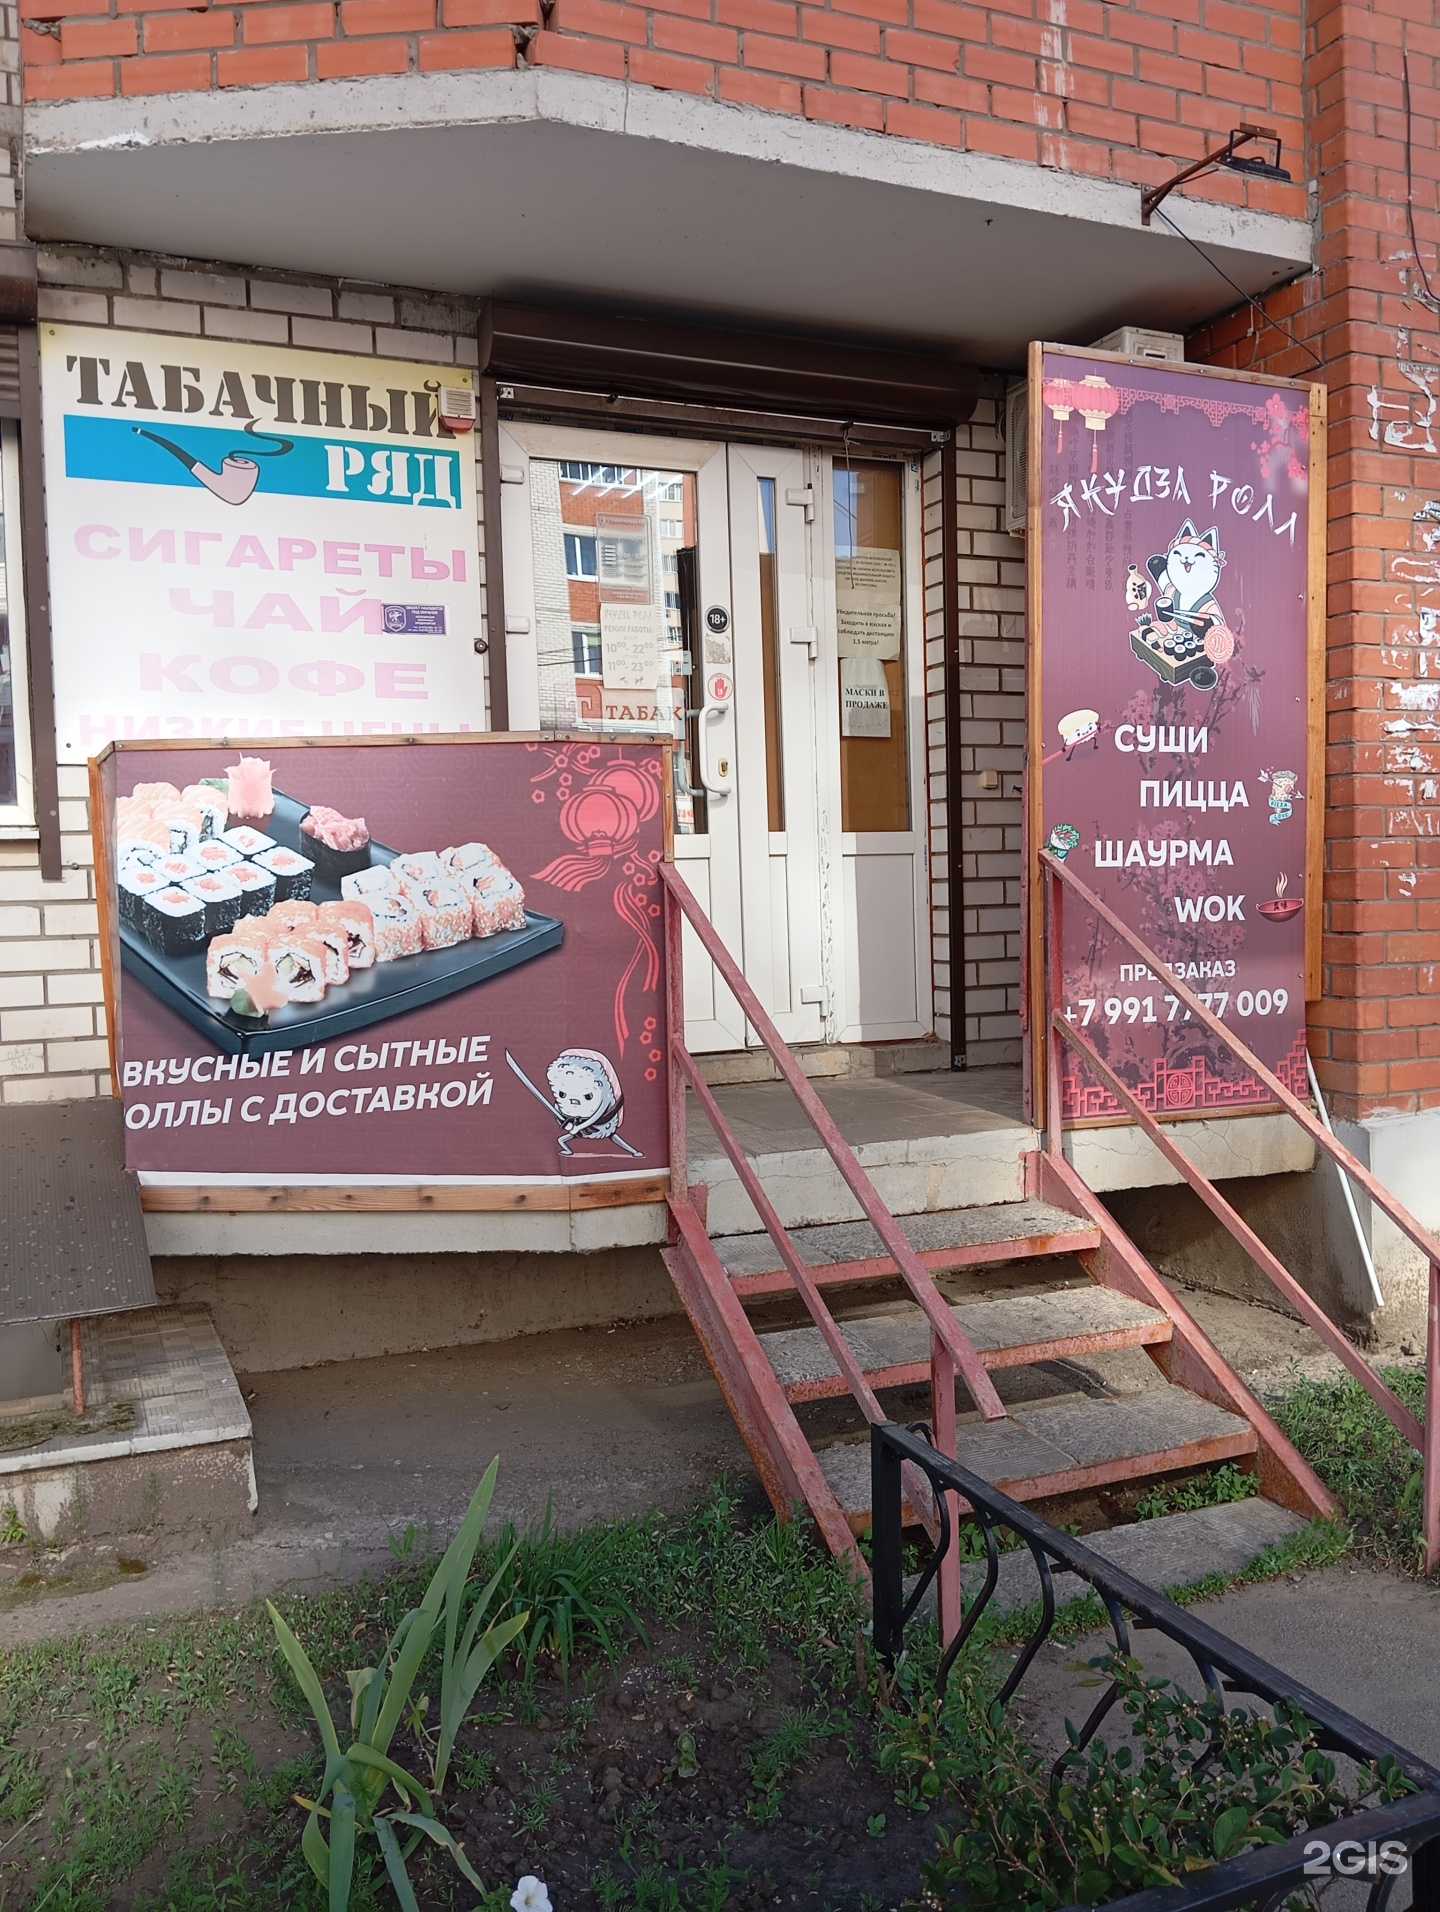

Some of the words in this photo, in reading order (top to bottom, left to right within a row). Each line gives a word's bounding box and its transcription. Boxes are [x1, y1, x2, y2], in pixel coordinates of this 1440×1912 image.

[66, 354, 457, 440] ТАБАЧНЫЙ
[324, 445, 456, 508] РЯД
[1209, 470, 1298, 547] РОЛЛ
[73, 523, 467, 582] СИГАРЕТЫ
[168, 587, 383, 635] ЧАЙ
[709, 613, 726, 625] 18+
[139, 653, 429, 700] КОФЕ
[845, 688, 877, 696] МАСКИ
[879, 688, 885, 697] В
[606, 705, 682, 721] ТАБАК
[845, 700, 888, 710] ПРОДАЖЕ
[1114, 723, 1209, 754] СУШИ
[1139, 780, 1249, 812] ПИЦЦА
[1094, 839, 1234, 868] ШАУРМА
[1174, 895, 1245, 923] WOK
[1063, 998, 1096, 1026] +7
[1104, 996, 1157, 1024] 991
[1236, 988, 1289, 1017] 009
[123, 1050, 293, 1088] ВКУСНЫЕ
[299, 1047, 326, 1075] И
[333, 1034, 491, 1072] СЫТНЫЕ
[123, 1098, 232, 1130] ОЛЛЫ
[240, 1096, 265, 1123] С
[268, 1070, 494, 1126] ДОСТАВКОЙ
